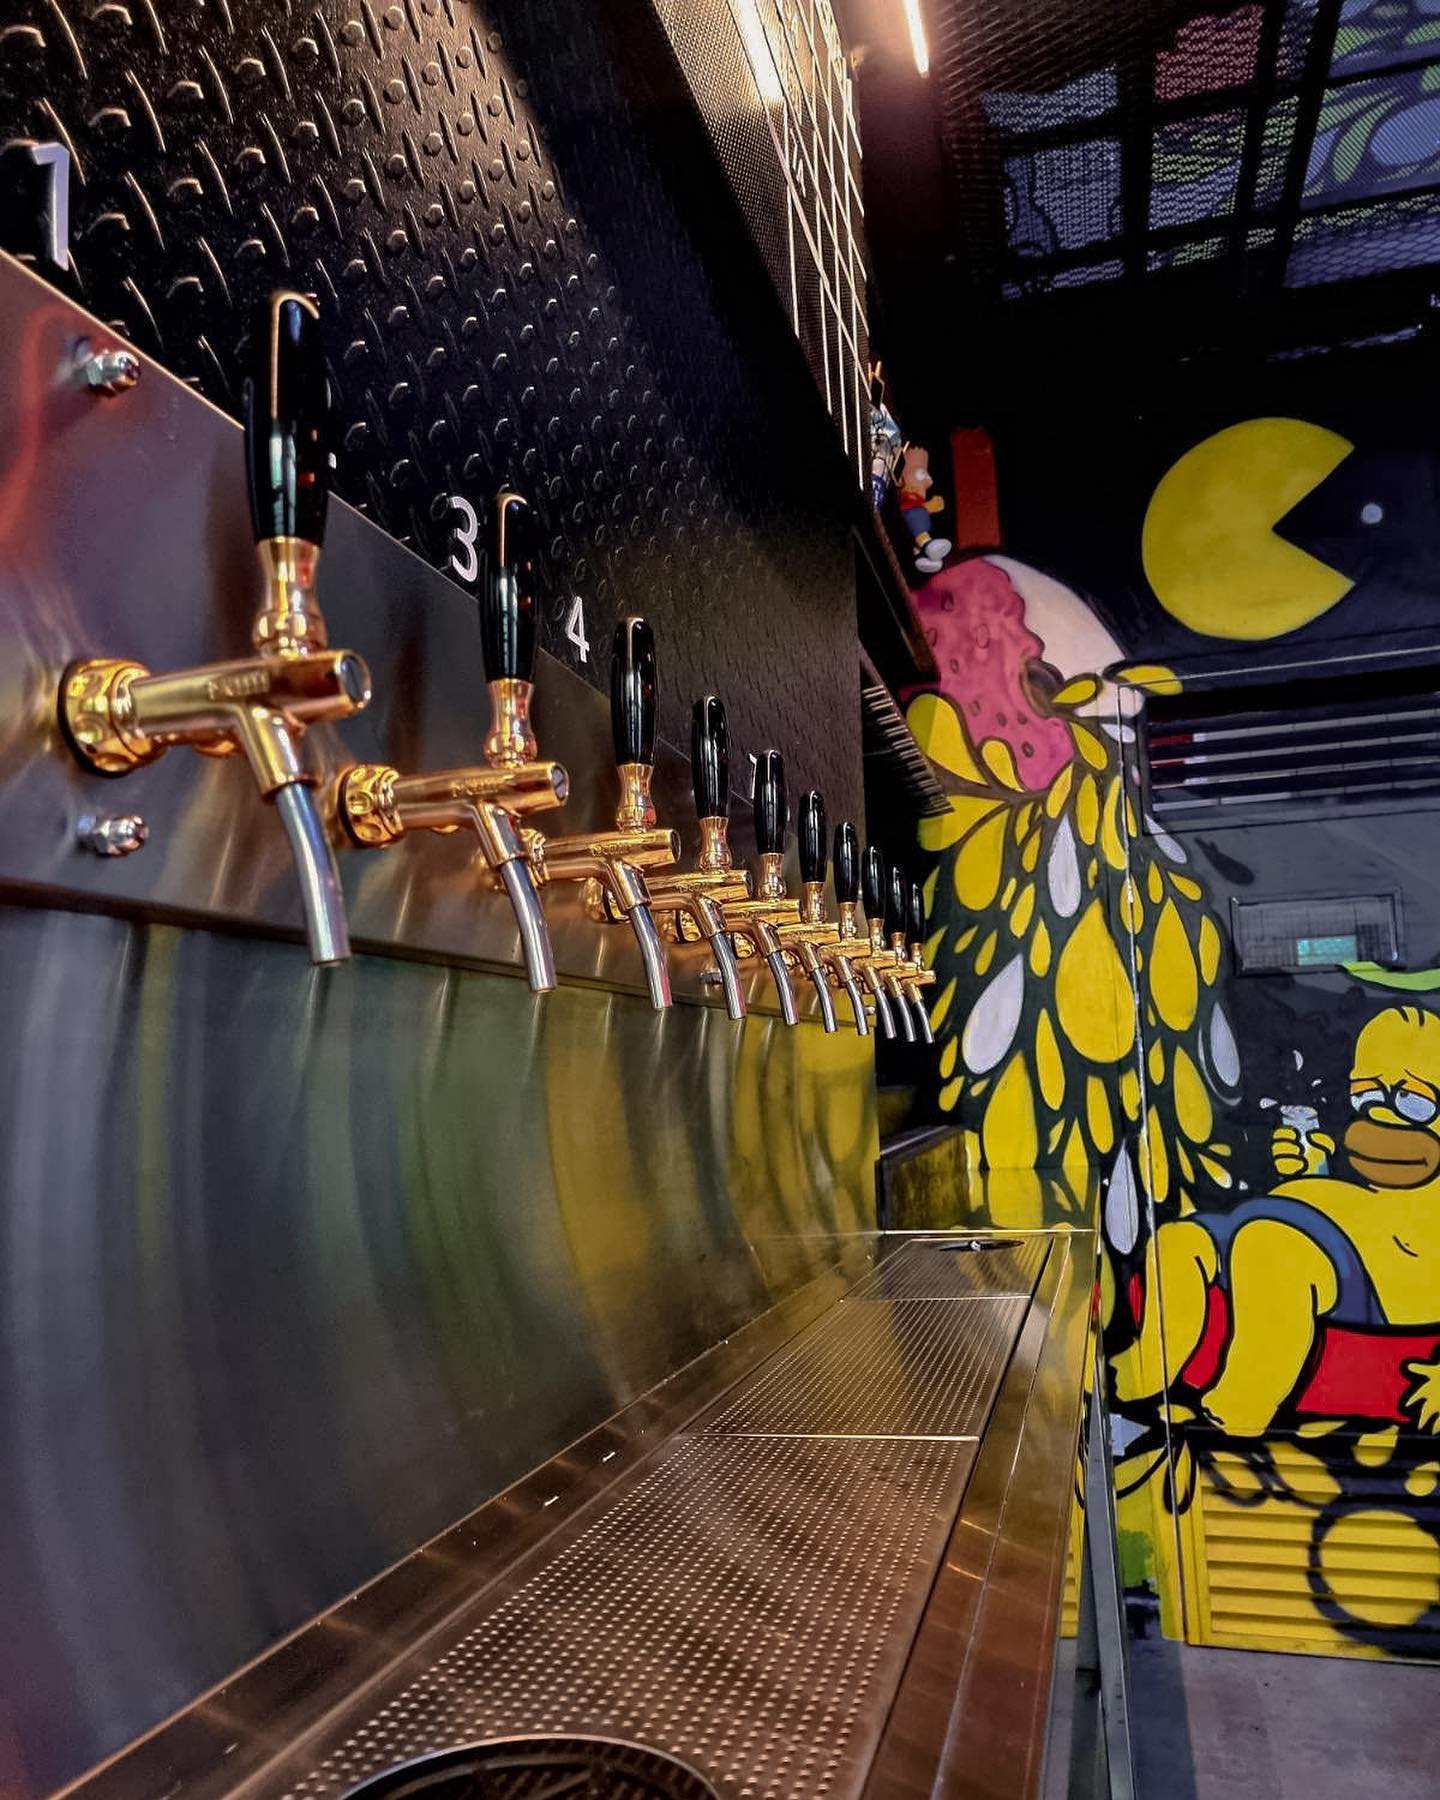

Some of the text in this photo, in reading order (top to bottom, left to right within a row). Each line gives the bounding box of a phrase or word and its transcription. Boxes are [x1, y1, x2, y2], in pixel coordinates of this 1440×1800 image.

[32, 142, 70, 271] 1
[451, 496, 478, 582] 3
[565, 596, 590, 663] 4
